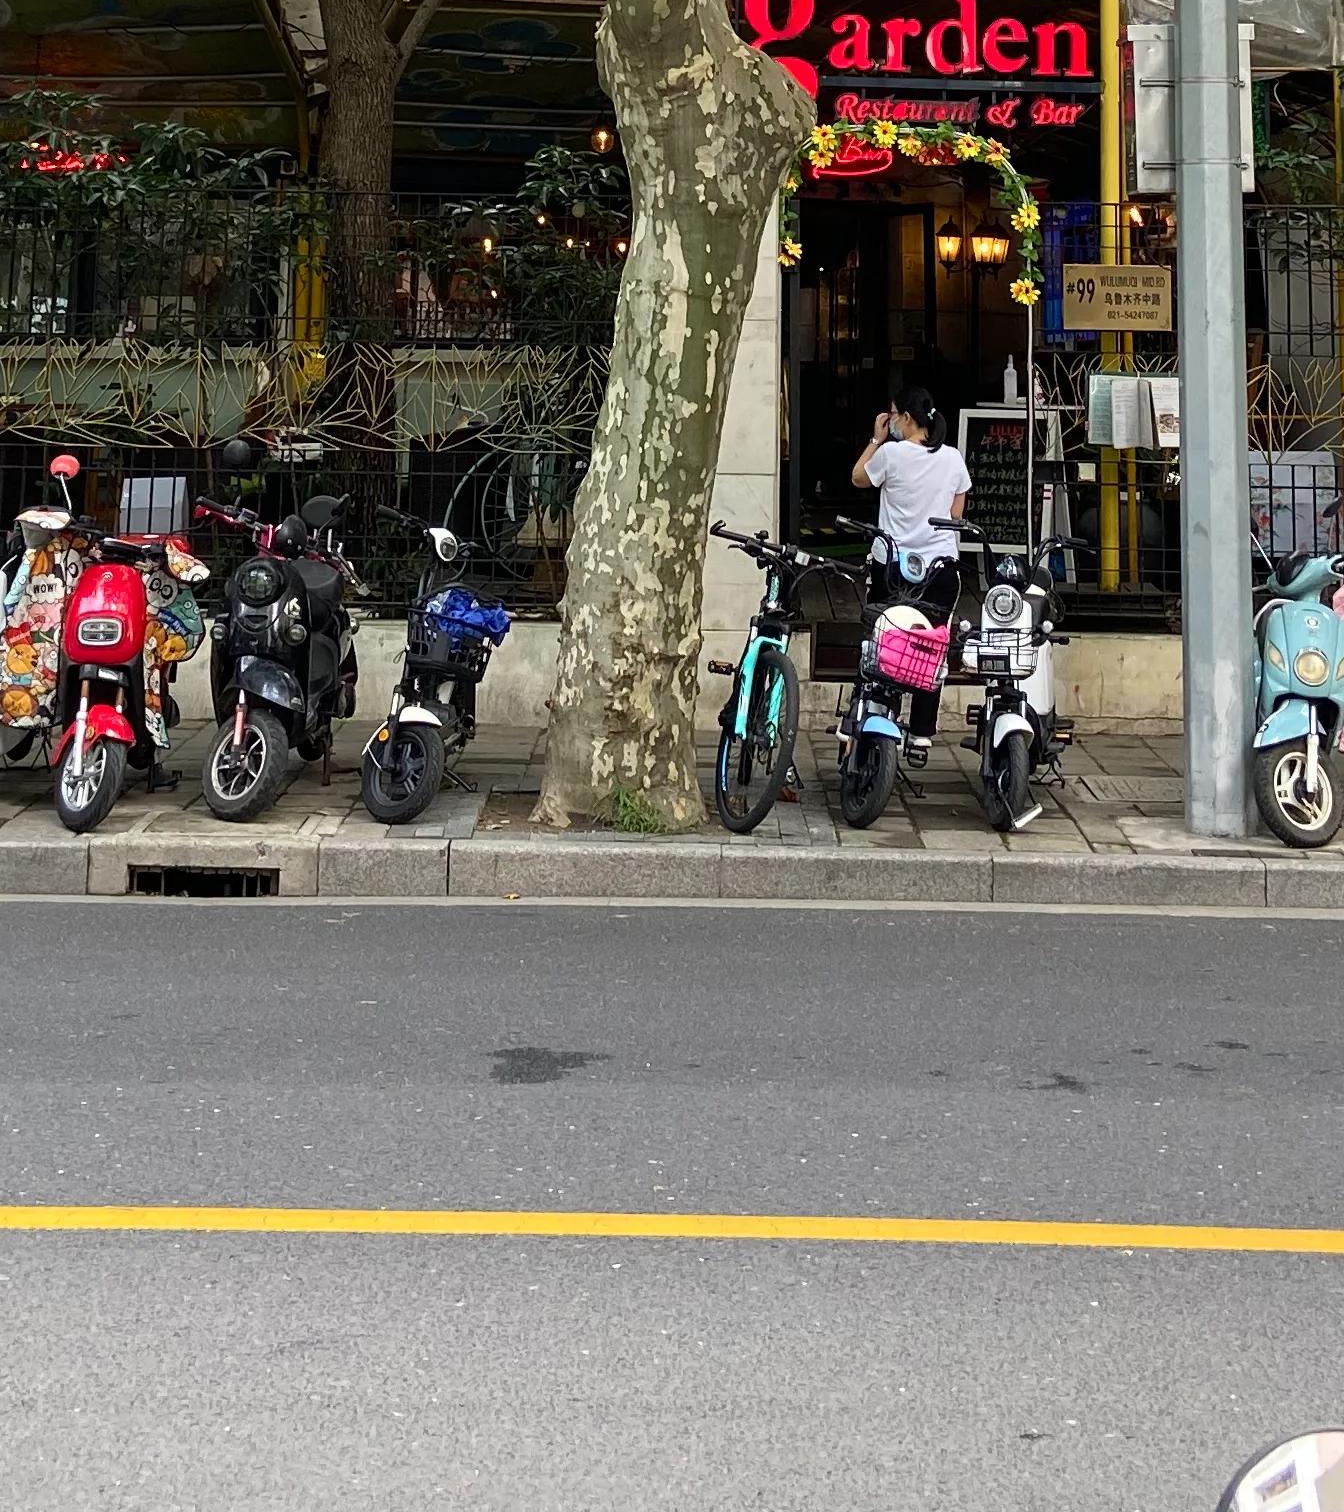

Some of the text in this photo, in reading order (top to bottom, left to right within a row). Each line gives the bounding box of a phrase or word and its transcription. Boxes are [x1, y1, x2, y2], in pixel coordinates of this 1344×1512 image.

[835, 93, 1084, 128] Restaurant & Bar
[1066, 278, 1095, 304] #99
[1104, 292, 1161, 306] 乌鲁木齐中路
